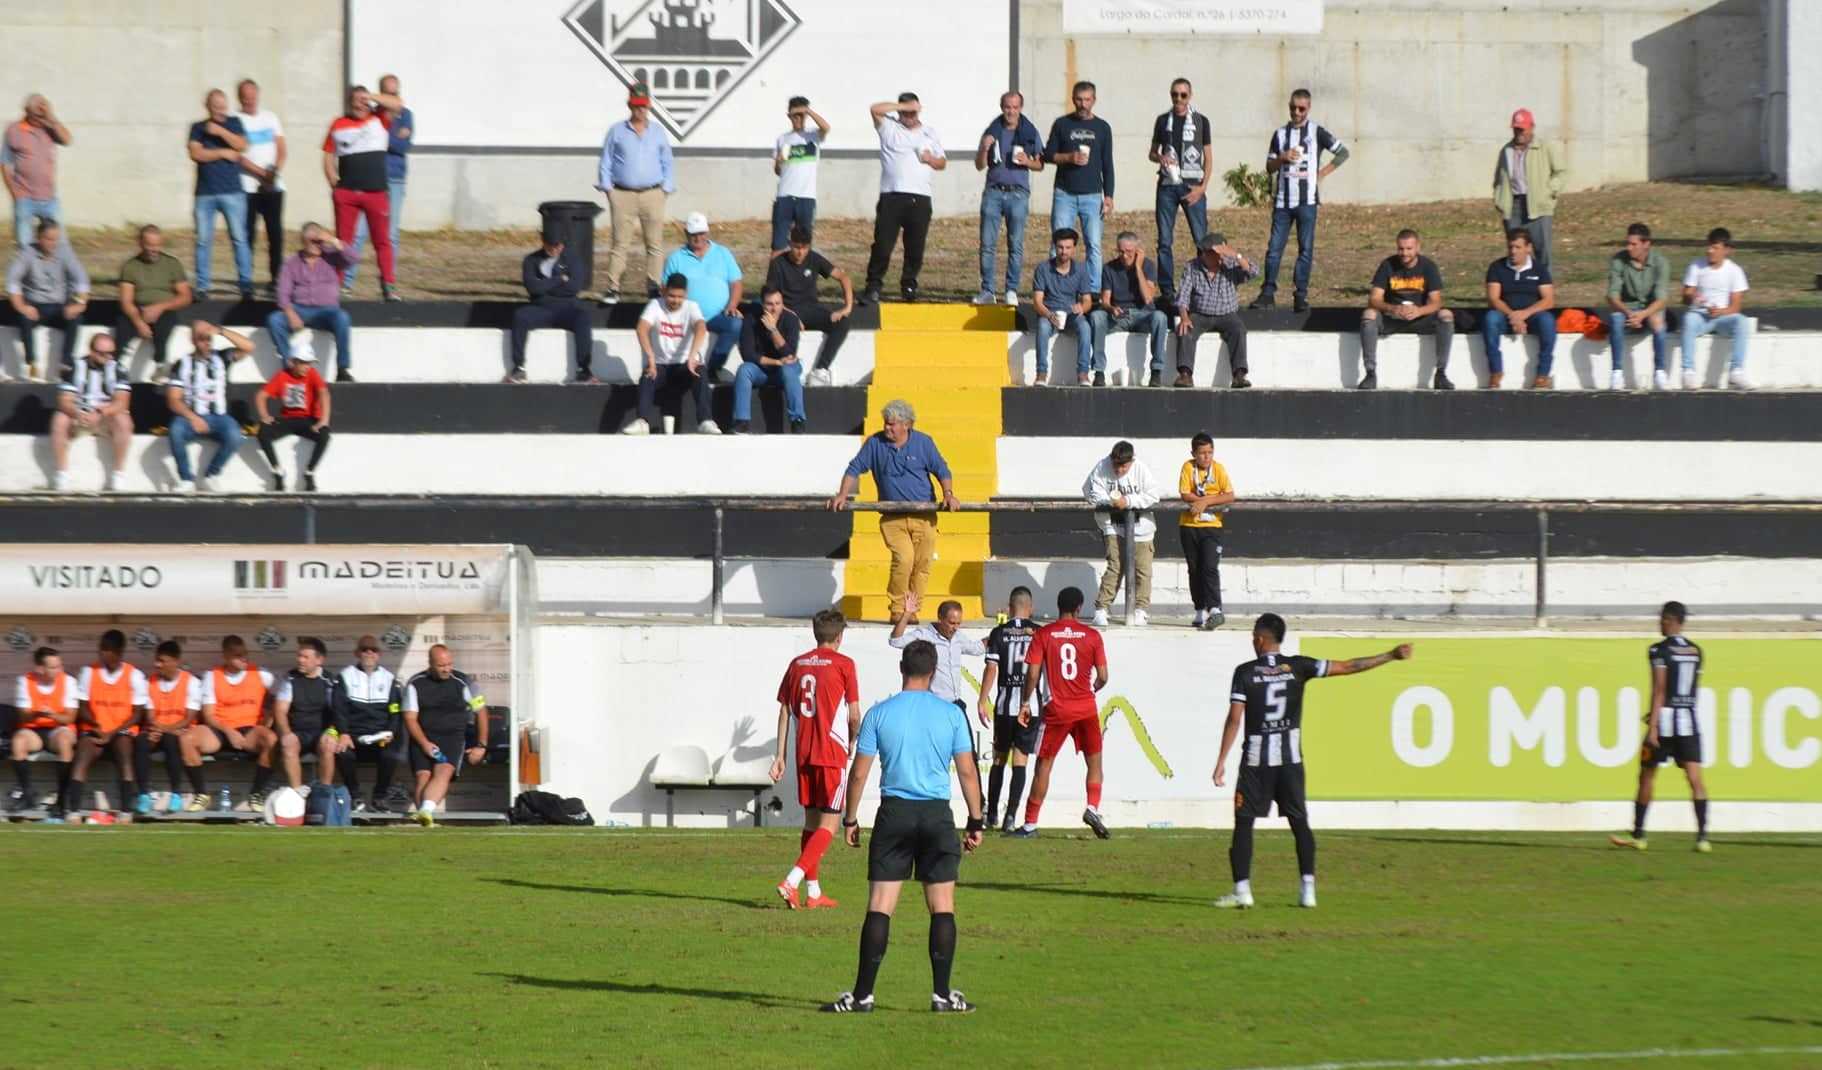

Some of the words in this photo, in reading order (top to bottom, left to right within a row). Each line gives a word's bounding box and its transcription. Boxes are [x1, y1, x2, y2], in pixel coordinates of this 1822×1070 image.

[29, 565, 162, 589] VISITADO
[1007, 641, 1030, 675] 14
[1060, 643, 1078, 681] 8
[800, 674, 817, 719] 3
[1265, 681, 1287, 721] 5
[1391, 686, 1454, 767] O
